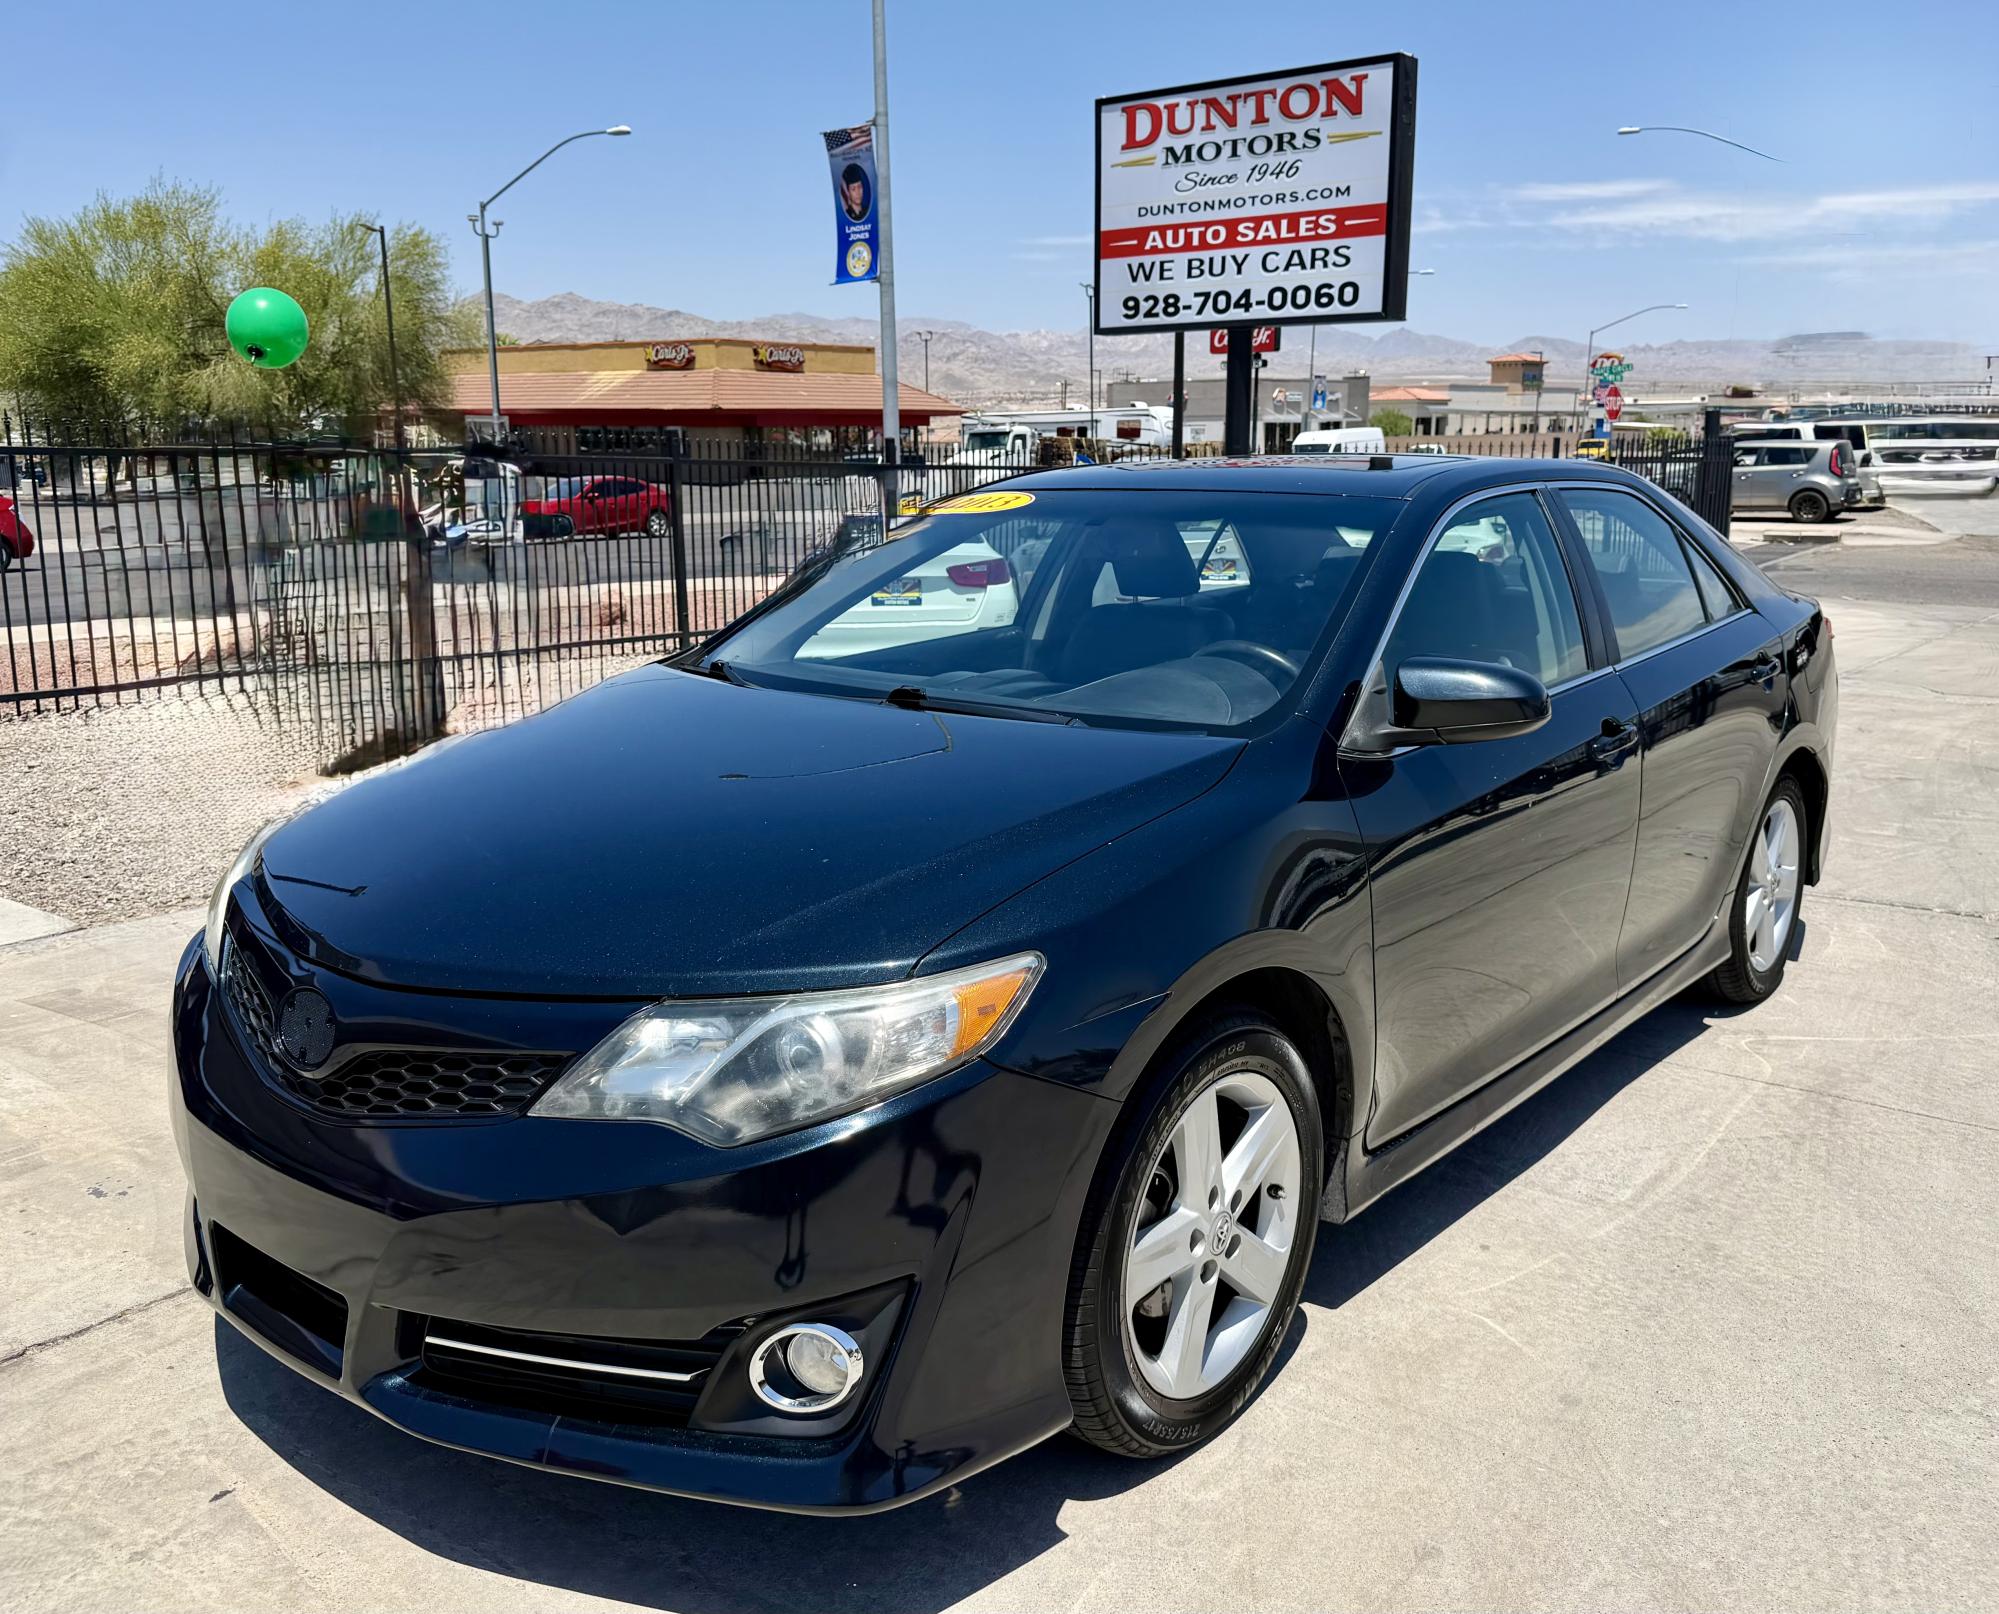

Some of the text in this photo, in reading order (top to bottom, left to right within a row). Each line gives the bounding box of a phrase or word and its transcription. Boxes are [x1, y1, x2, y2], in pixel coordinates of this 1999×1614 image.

[1121, 73, 1369, 151] DUNTON
[1162, 127, 1322, 167] MOTORS
[1174, 159, 1303, 193] Since 1946
[1137, 185, 1351, 218] DUNTONMOTORS.COM
[1144, 214, 1337, 251] AUTO SALES
[1127, 244, 1352, 283] WE BUY CARS
[1122, 281, 1360, 320] 928-704-0060
[1606, 396, 1622, 410] STOP
